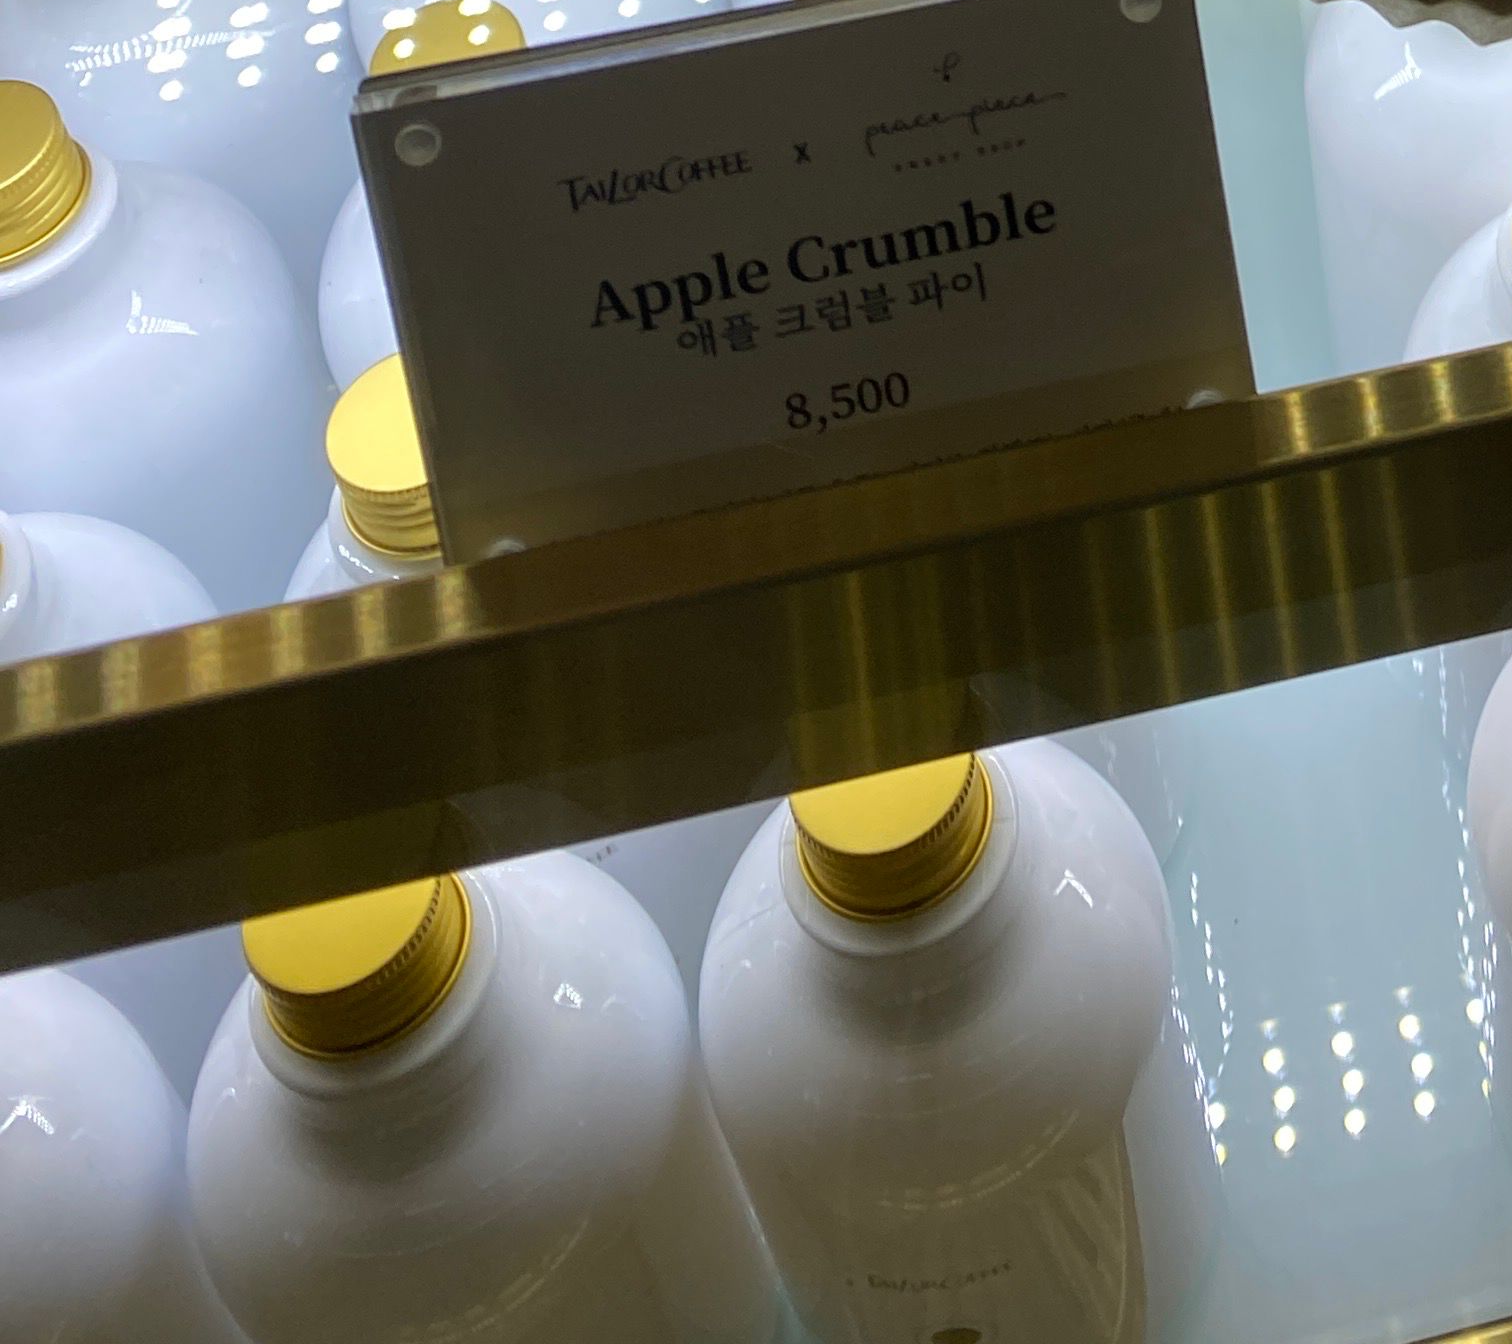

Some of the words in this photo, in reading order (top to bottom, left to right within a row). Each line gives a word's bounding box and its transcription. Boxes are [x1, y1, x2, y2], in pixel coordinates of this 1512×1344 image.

[590, 251, 772, 333] Apple
[785, 191, 1058, 283] Crumble
[676, 312, 760, 358] 애플
[774, 282, 896, 339] 크럼블
[906, 261, 987, 311] 파이
[785, 371, 911, 435] 8,500
